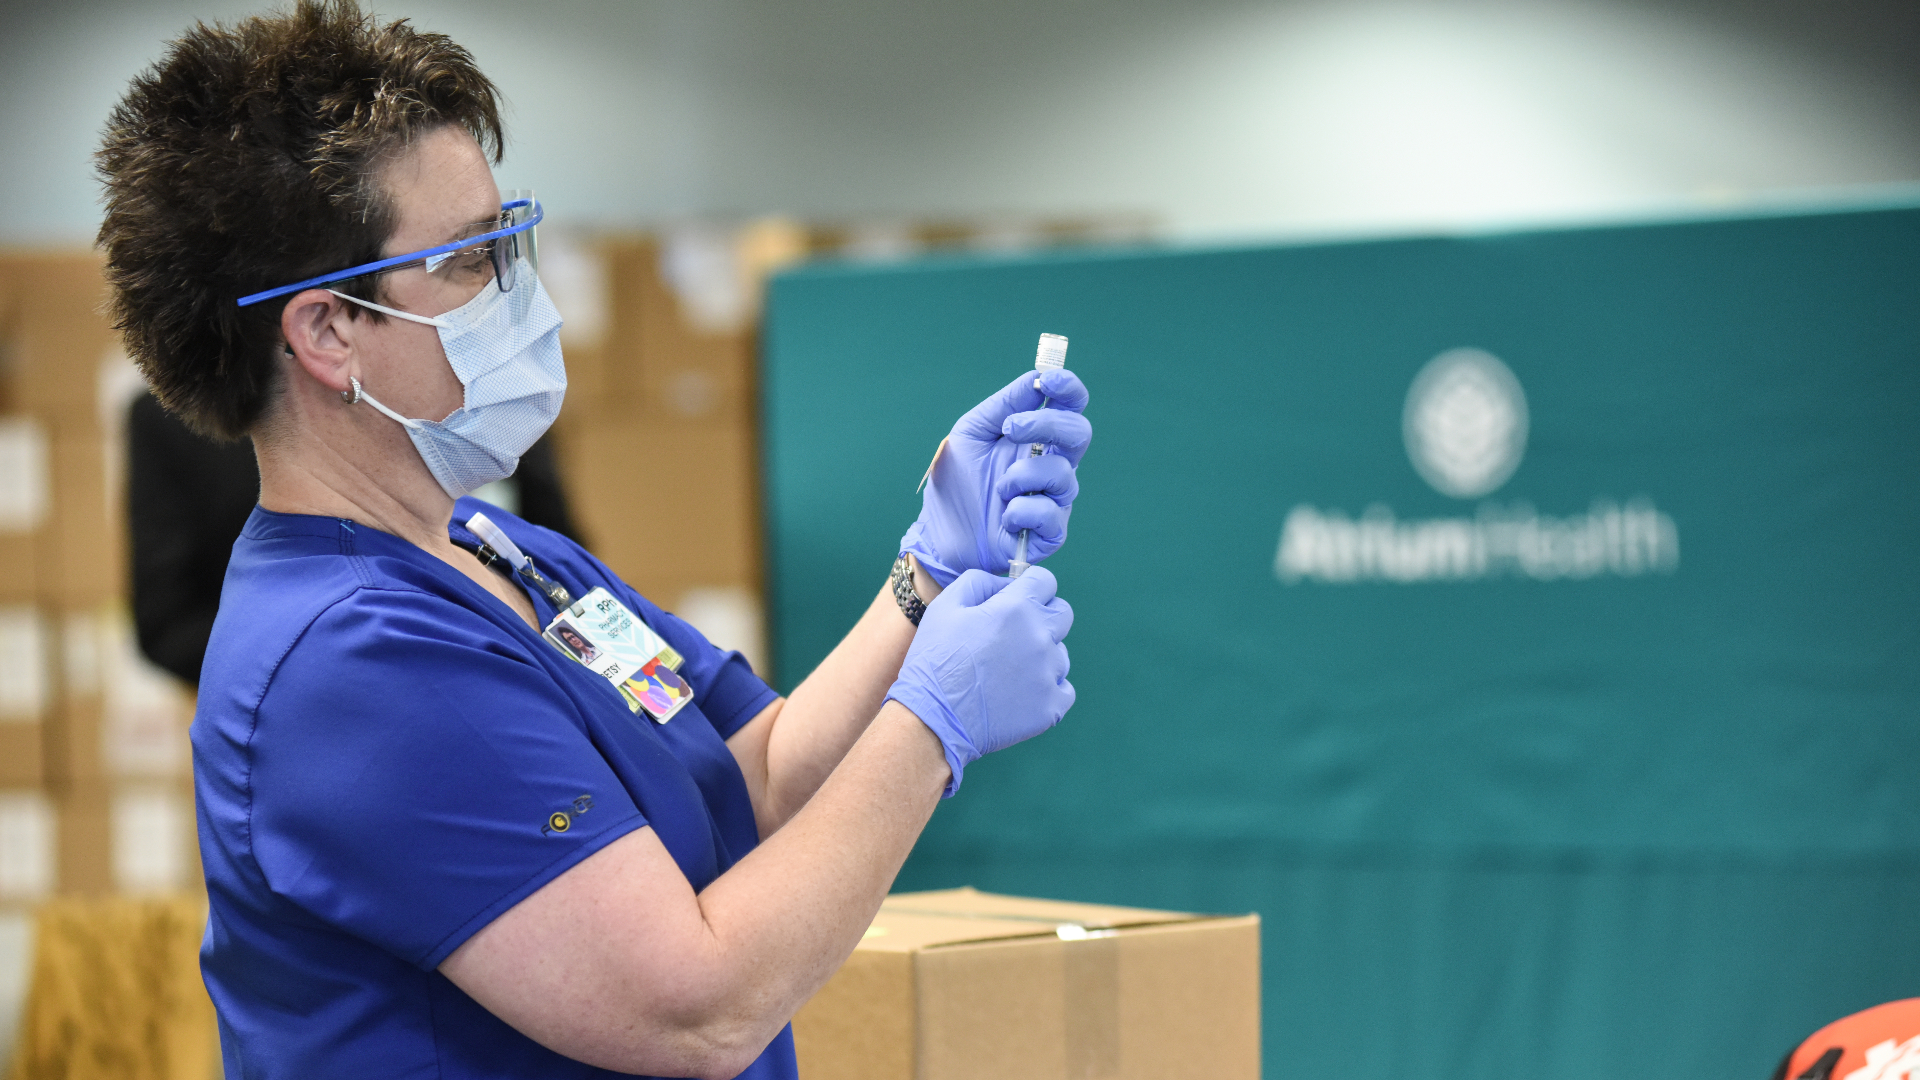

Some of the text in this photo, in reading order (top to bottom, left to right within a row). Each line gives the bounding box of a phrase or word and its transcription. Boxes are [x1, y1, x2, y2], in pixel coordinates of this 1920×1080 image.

[597, 598, 617, 614] RPh
[598, 608, 626, 631] PHARMACY
[607, 618, 633, 639] SERVICES
